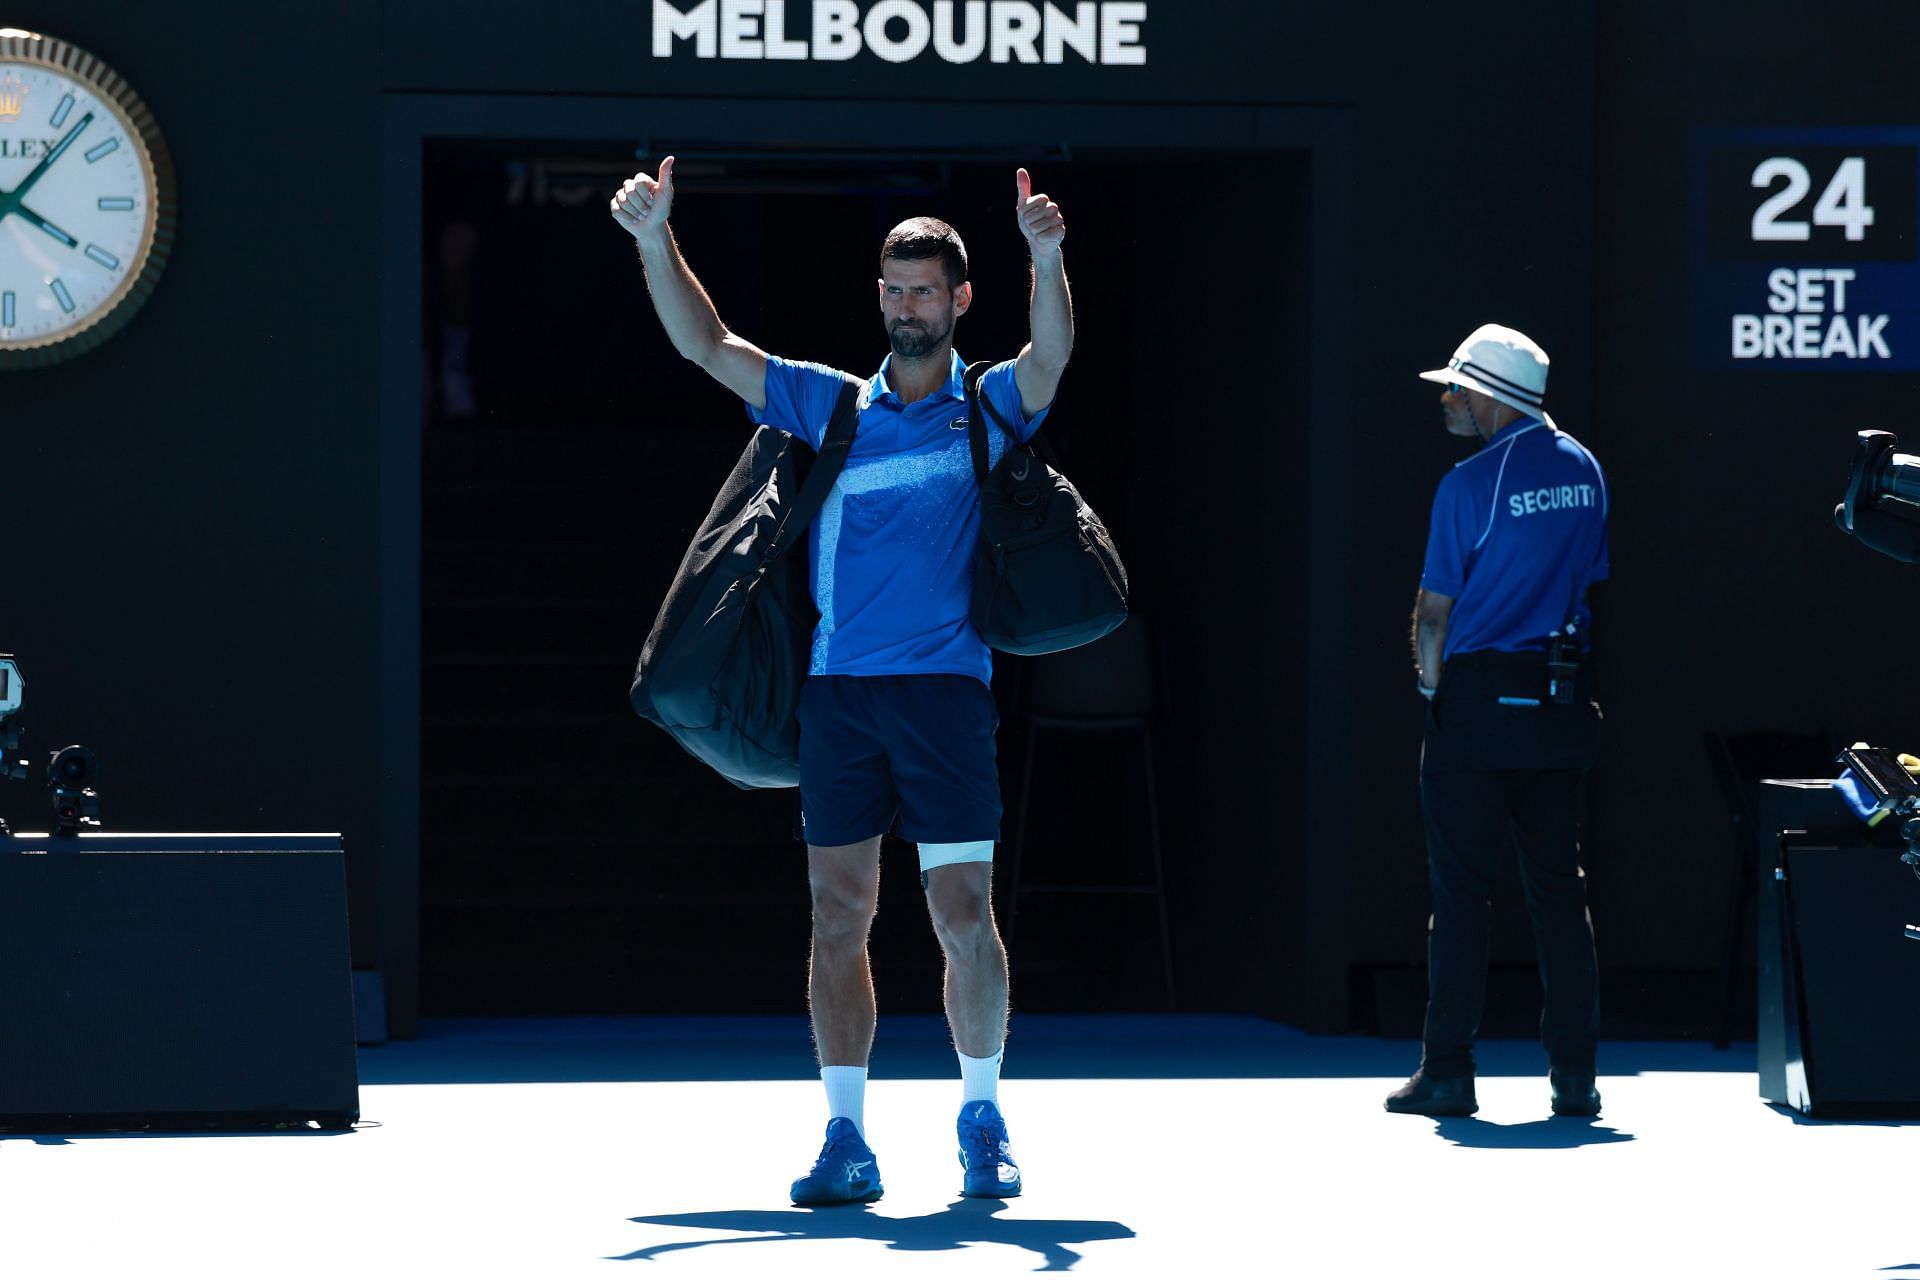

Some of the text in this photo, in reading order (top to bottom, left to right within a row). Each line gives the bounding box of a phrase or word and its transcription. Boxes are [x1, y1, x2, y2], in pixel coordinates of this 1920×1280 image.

[652, 0, 1147, 65] MELBOURNE
[1751, 157, 1875, 241] 24
[1767, 267, 1856, 313] SET
[1731, 314, 1892, 359] BREAK
[1508, 484, 1596, 518] SECURITY
